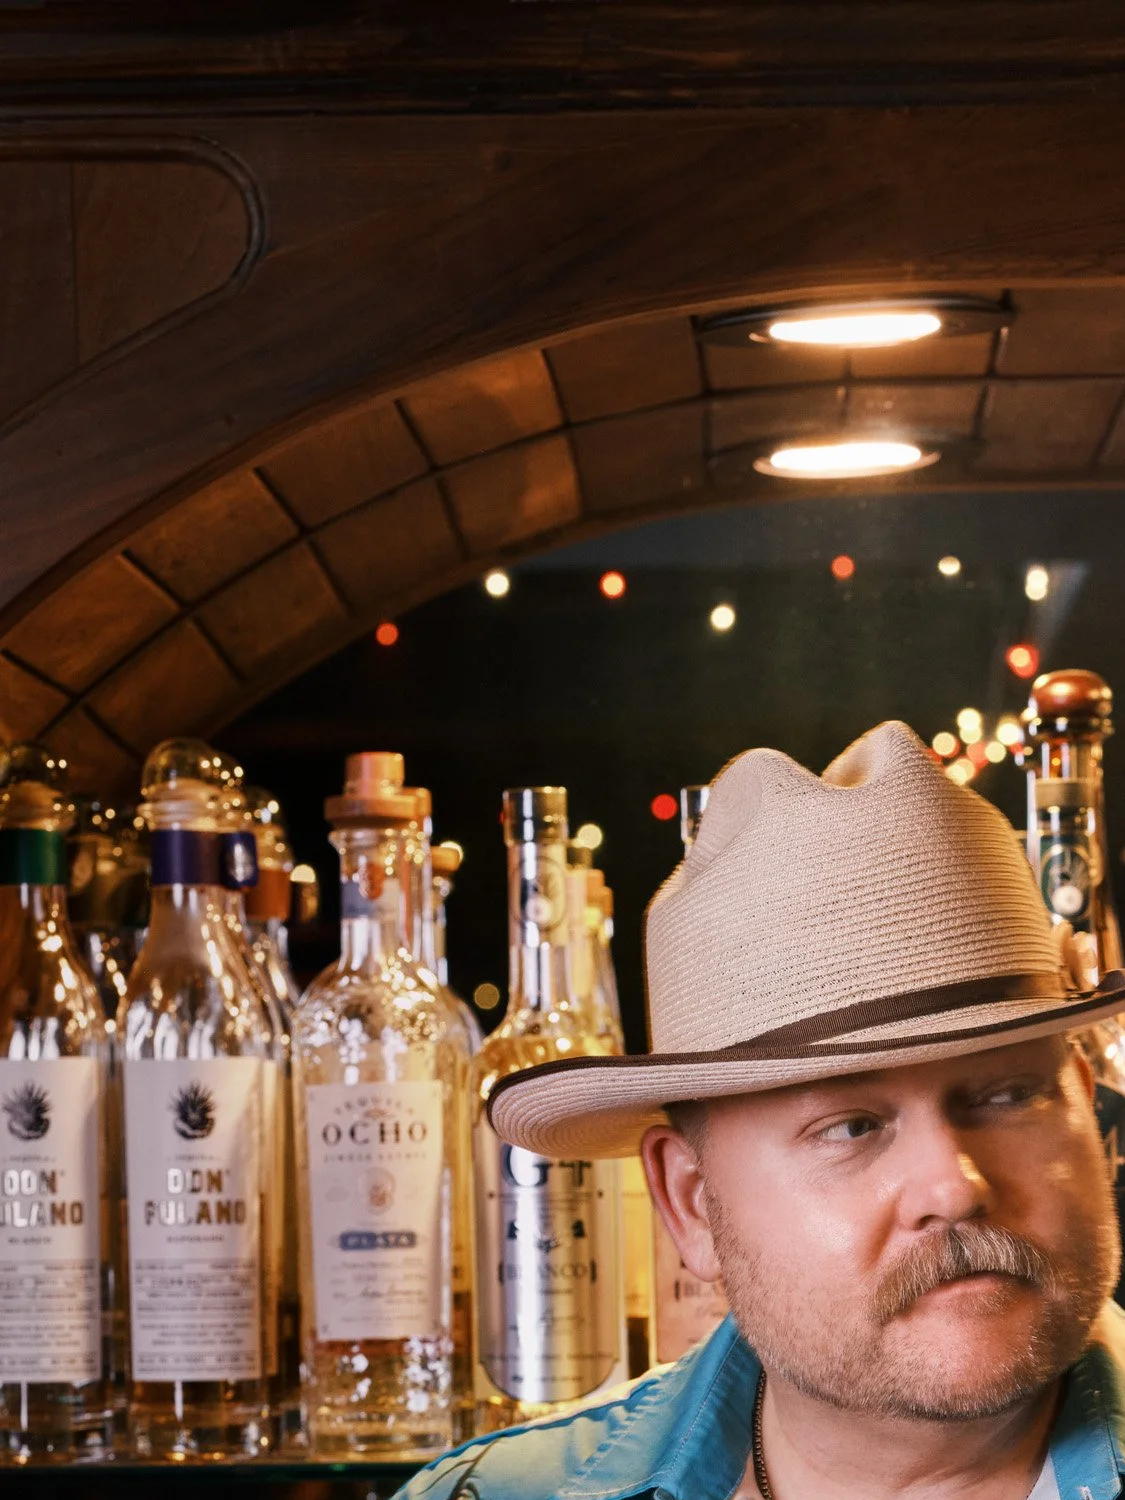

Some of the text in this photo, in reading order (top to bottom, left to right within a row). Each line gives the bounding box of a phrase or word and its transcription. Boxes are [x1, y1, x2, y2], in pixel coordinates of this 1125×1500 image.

[322, 1121, 428, 1147] OCHO
[4, 1168, 58, 1195] DON
[167, 1167, 223, 1195] DON
[144, 1200, 246, 1226] FULANO
